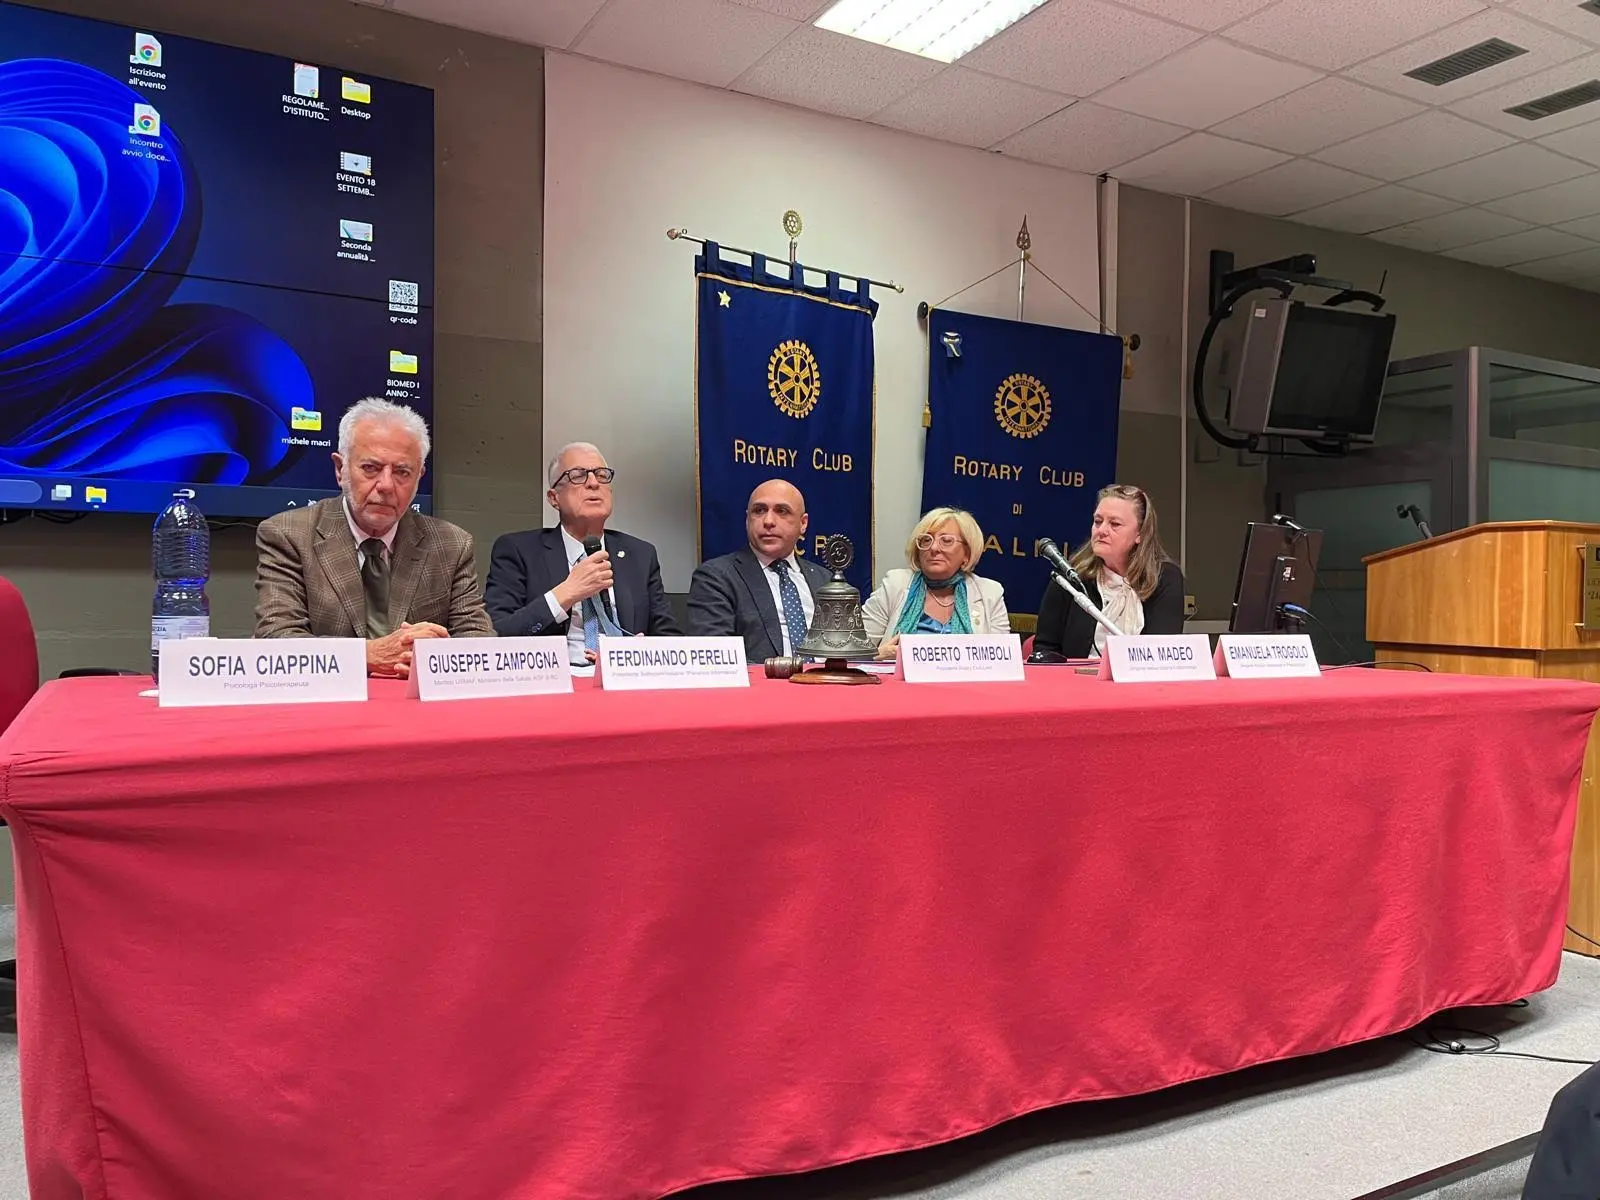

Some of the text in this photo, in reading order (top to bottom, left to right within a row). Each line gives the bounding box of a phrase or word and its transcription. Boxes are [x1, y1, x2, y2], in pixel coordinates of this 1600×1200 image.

[129, 66, 167, 80] Iscrizione
[128, 78, 167, 91] all'evento
[282, 94, 330, 111] REGOLAME...
[283, 105, 330, 121] D'ISTITUTO...
[341, 106, 371, 120] Desktop
[129, 137, 164, 149] Incontro
[121, 149, 144, 158] avvio
[336, 172, 376, 187] EVENTO 18
[337, 183, 375, 197] SETTEMB...
[341, 240, 372, 252] Seconda
[389, 316, 418, 325] qr-code
[386, 379, 416, 389] BIOMED
[385, 389, 409, 398] ANNO
[281, 436, 310, 446] michele
[734, 439, 853, 473] ROTARY CLUB
[953, 455, 1085, 488] ROTARY CLUB
[1012, 503, 1023, 515] DI
[608, 649, 738, 667] FERDINANDO PERELLI
[912, 646, 1012, 662] ROBERTO TRIMBOLI
[1127, 646, 1193, 662] MINA MADEO
[1229, 645, 1309, 660] EMANUELA TROGOLO
[189, 654, 340, 677] SOFIA CIAPPINA
[428, 651, 560, 674] GIUSEPPE ZAMPOGNA
